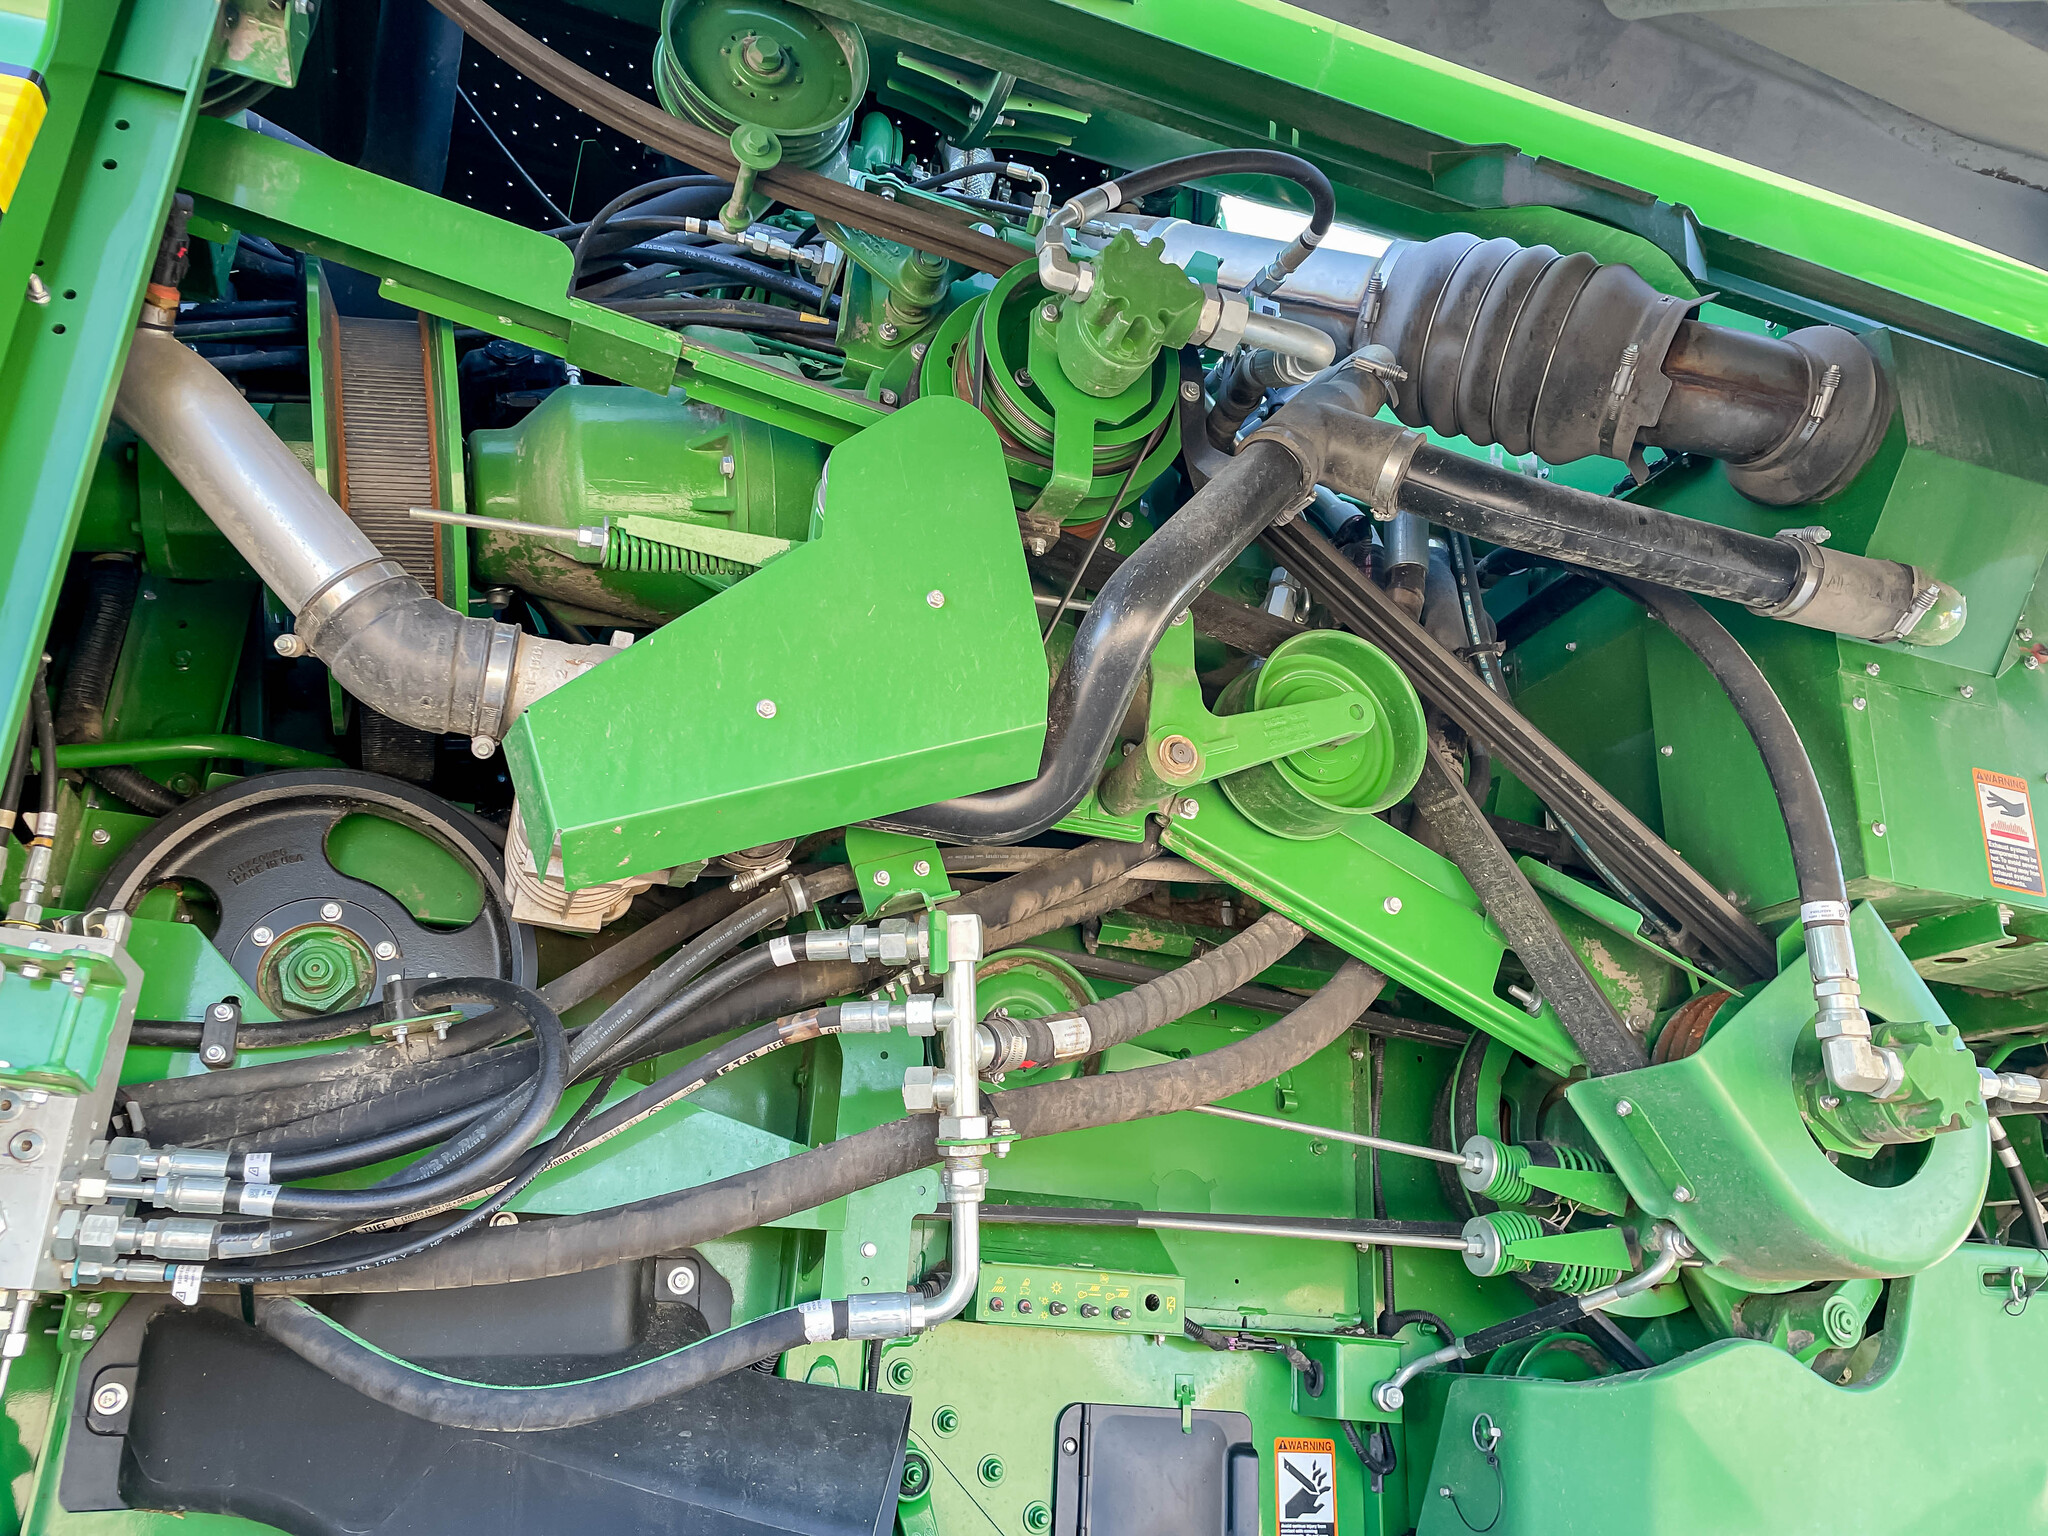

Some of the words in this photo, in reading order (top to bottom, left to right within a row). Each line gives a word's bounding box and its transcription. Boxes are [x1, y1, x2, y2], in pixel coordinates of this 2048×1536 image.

[1984, 773, 2026, 791] WARNING
[321, 1268, 350, 1278] MADE
[355, 1264, 371, 1272] IN
[374, 1253, 408, 1267] ITALY
[449, 1222, 475, 1238] TYPE
[1288, 1441, 1332, 1451] WARNING
